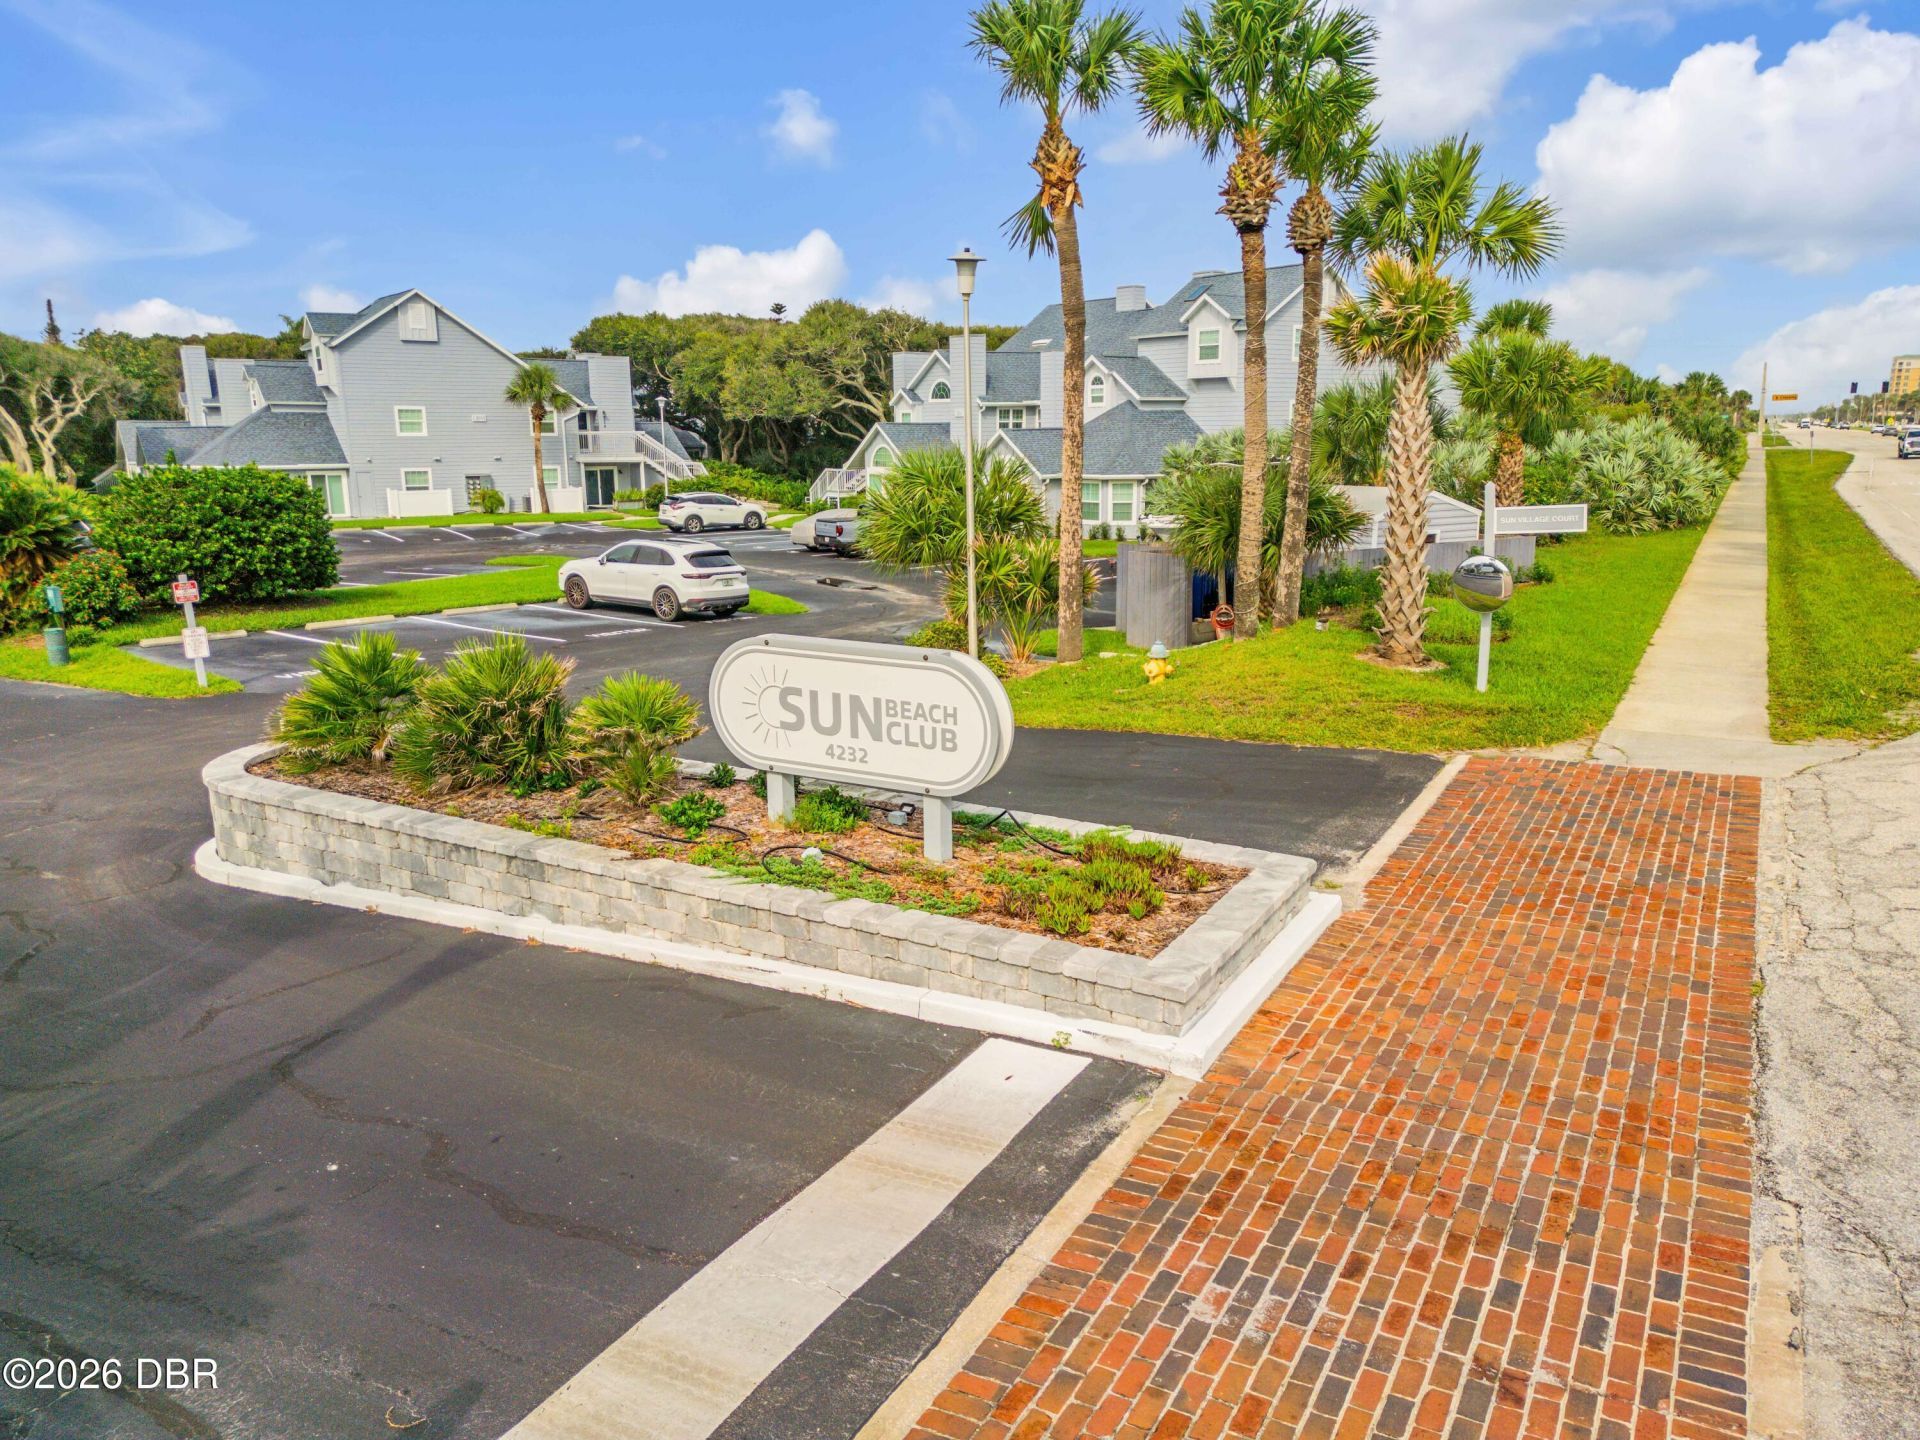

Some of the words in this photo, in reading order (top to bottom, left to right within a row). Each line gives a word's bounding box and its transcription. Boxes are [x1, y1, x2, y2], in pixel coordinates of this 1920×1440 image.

[1500, 516, 1516, 524] SUN
[1517, 515, 1550, 523] VILLAGE
[1551, 514, 1579, 522] COURT
[778, 686, 884, 742] SUN
[885, 699, 958, 726] BEACH
[886, 721, 958, 752] CLUB
[825, 743, 868, 764] 4232
